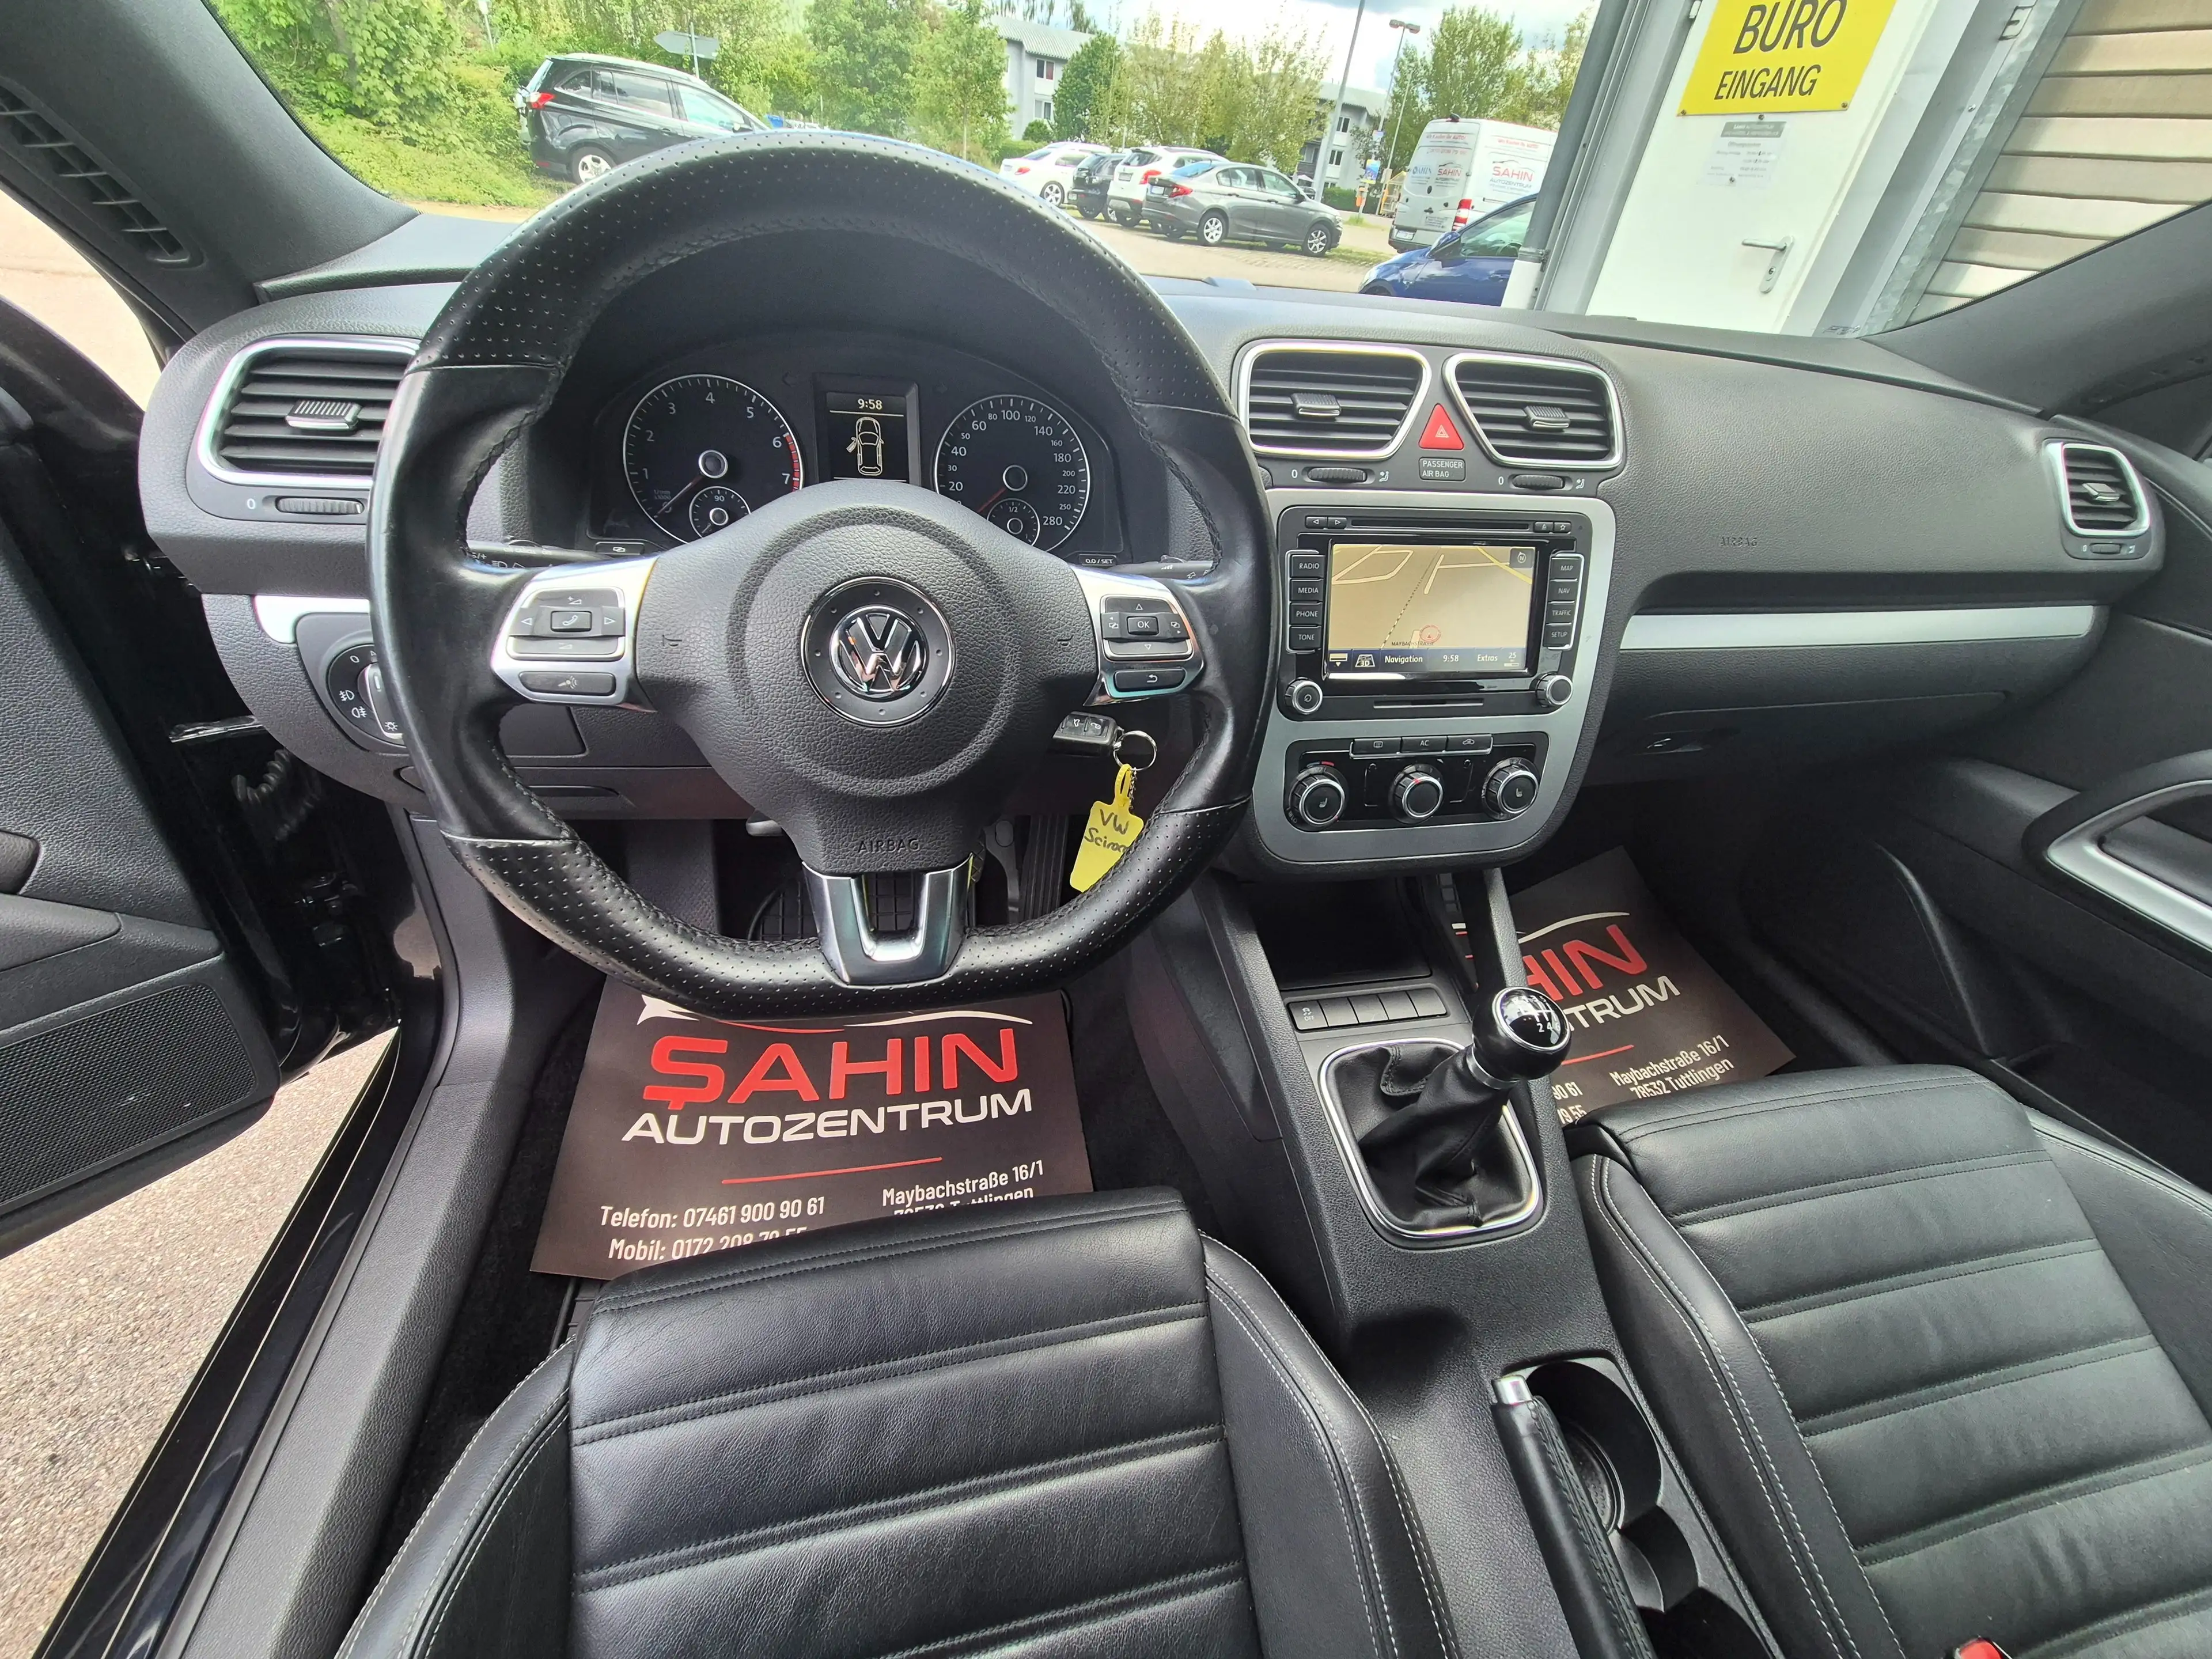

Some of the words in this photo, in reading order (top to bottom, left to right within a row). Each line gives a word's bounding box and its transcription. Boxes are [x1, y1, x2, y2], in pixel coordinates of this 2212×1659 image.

[1714, 65, 1821, 100] EINGANG
[706, 392, 715, 403] 4
[669, 403, 676, 414] 3
[858, 399, 882, 410] 9:58
[747, 407, 754, 419] 5
[1001, 411, 1020, 421] 100
[972, 421, 987, 431] 60
[1034, 426, 1053, 436] 140
[646, 430, 654, 441] 2
[772, 437, 782, 448] 6
[951, 446, 967, 456] 40
[1054, 453, 1071, 463] 180
[1422, 460, 1463, 468] PASSENGER
[642, 468, 649, 479] 1
[782, 473, 790, 484] 7
[949, 482, 963, 491] 20
[1058, 485, 1076, 494] 220
[1043, 517, 1063, 526] 280
[1720, 536, 1758, 547] AIRBAG
[1385, 655, 1423, 664] Navigation
[1443, 654, 1459, 662] 9:58
[1420, 739, 1429, 747] AC
[1100, 809, 1130, 835] VW
[858, 838, 920, 854] AIRBAG
[1536, 1022, 1544, 1033] 2
[1609, 1051, 1701, 1086] Maybachstraße
[1698, 1035, 1730, 1057] 16/1
[1630, 1080, 1671, 1099] 78532
[1665, 1059, 1734, 1091] Tuttlingen
[1565, 1081, 1584, 1097] 61
[622, 1088, 1032, 1145] AUTOZENTRUM
[882, 1171, 1009, 1208] Maybachstraße
[1012, 1160, 1044, 1182] 16/1
[600, 1206, 678, 1228] Telefon:
[683, 1209, 736, 1228] 07461
[740, 1202, 775, 1224] 900
[779, 1199, 803, 1218] 90
[806, 1196, 825, 1215] 61
[608, 1238, 666, 1261] Mobil:
[671, 1237, 714, 1259] 0172
